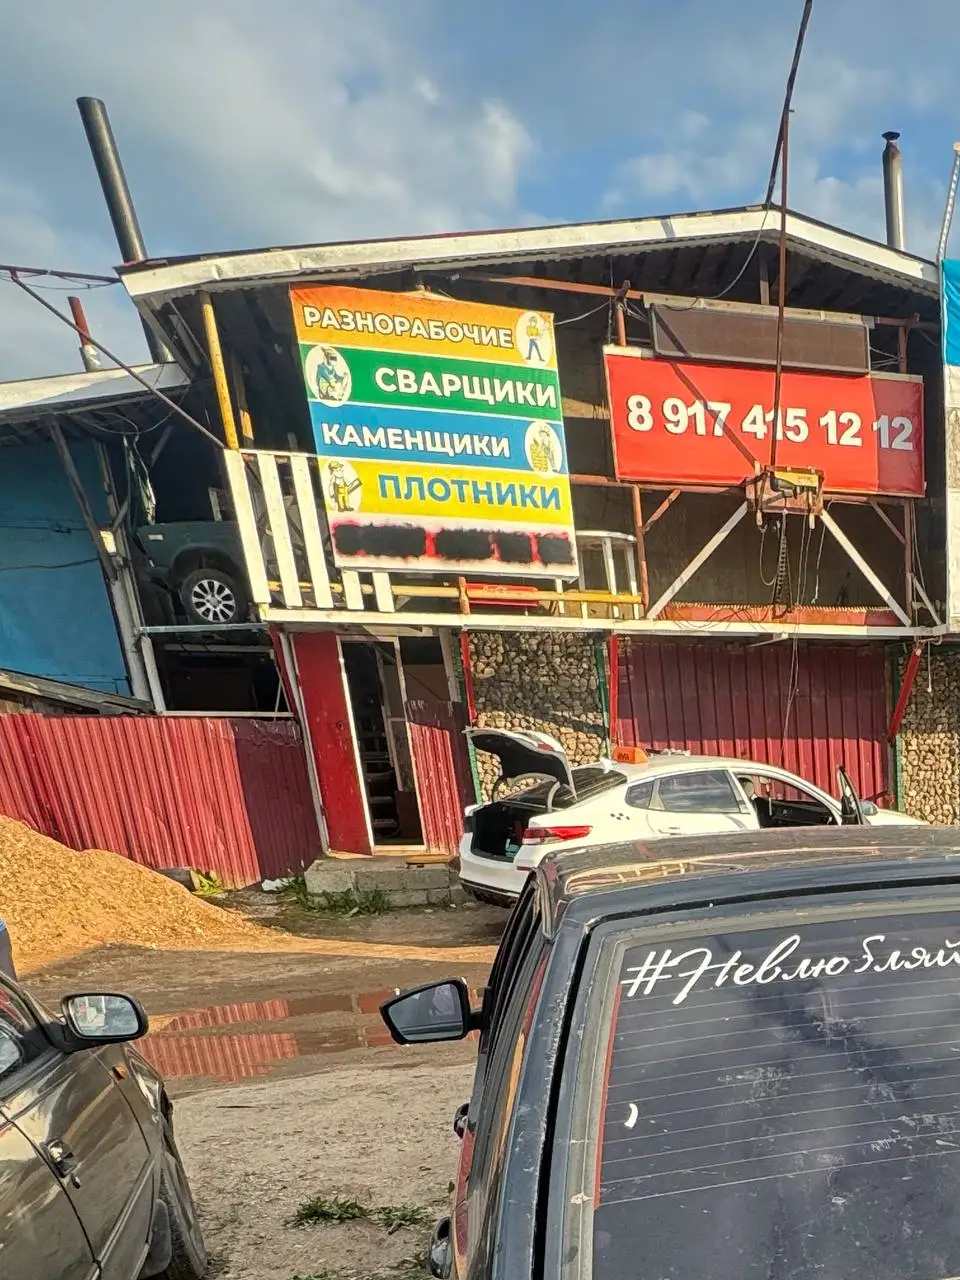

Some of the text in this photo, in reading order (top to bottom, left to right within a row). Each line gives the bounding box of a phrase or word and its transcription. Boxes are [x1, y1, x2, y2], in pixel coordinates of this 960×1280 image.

[302, 306, 514, 350] РАЗНОРАБОЧИЕ
[375, 367, 557, 409] СВАРЩИКИ
[321, 422, 511, 459] КАМЕНЩИКИ
[626, 394, 914, 450] 8 917 415 12 12
[378, 474, 562, 511] ПЛОТНИКИ
